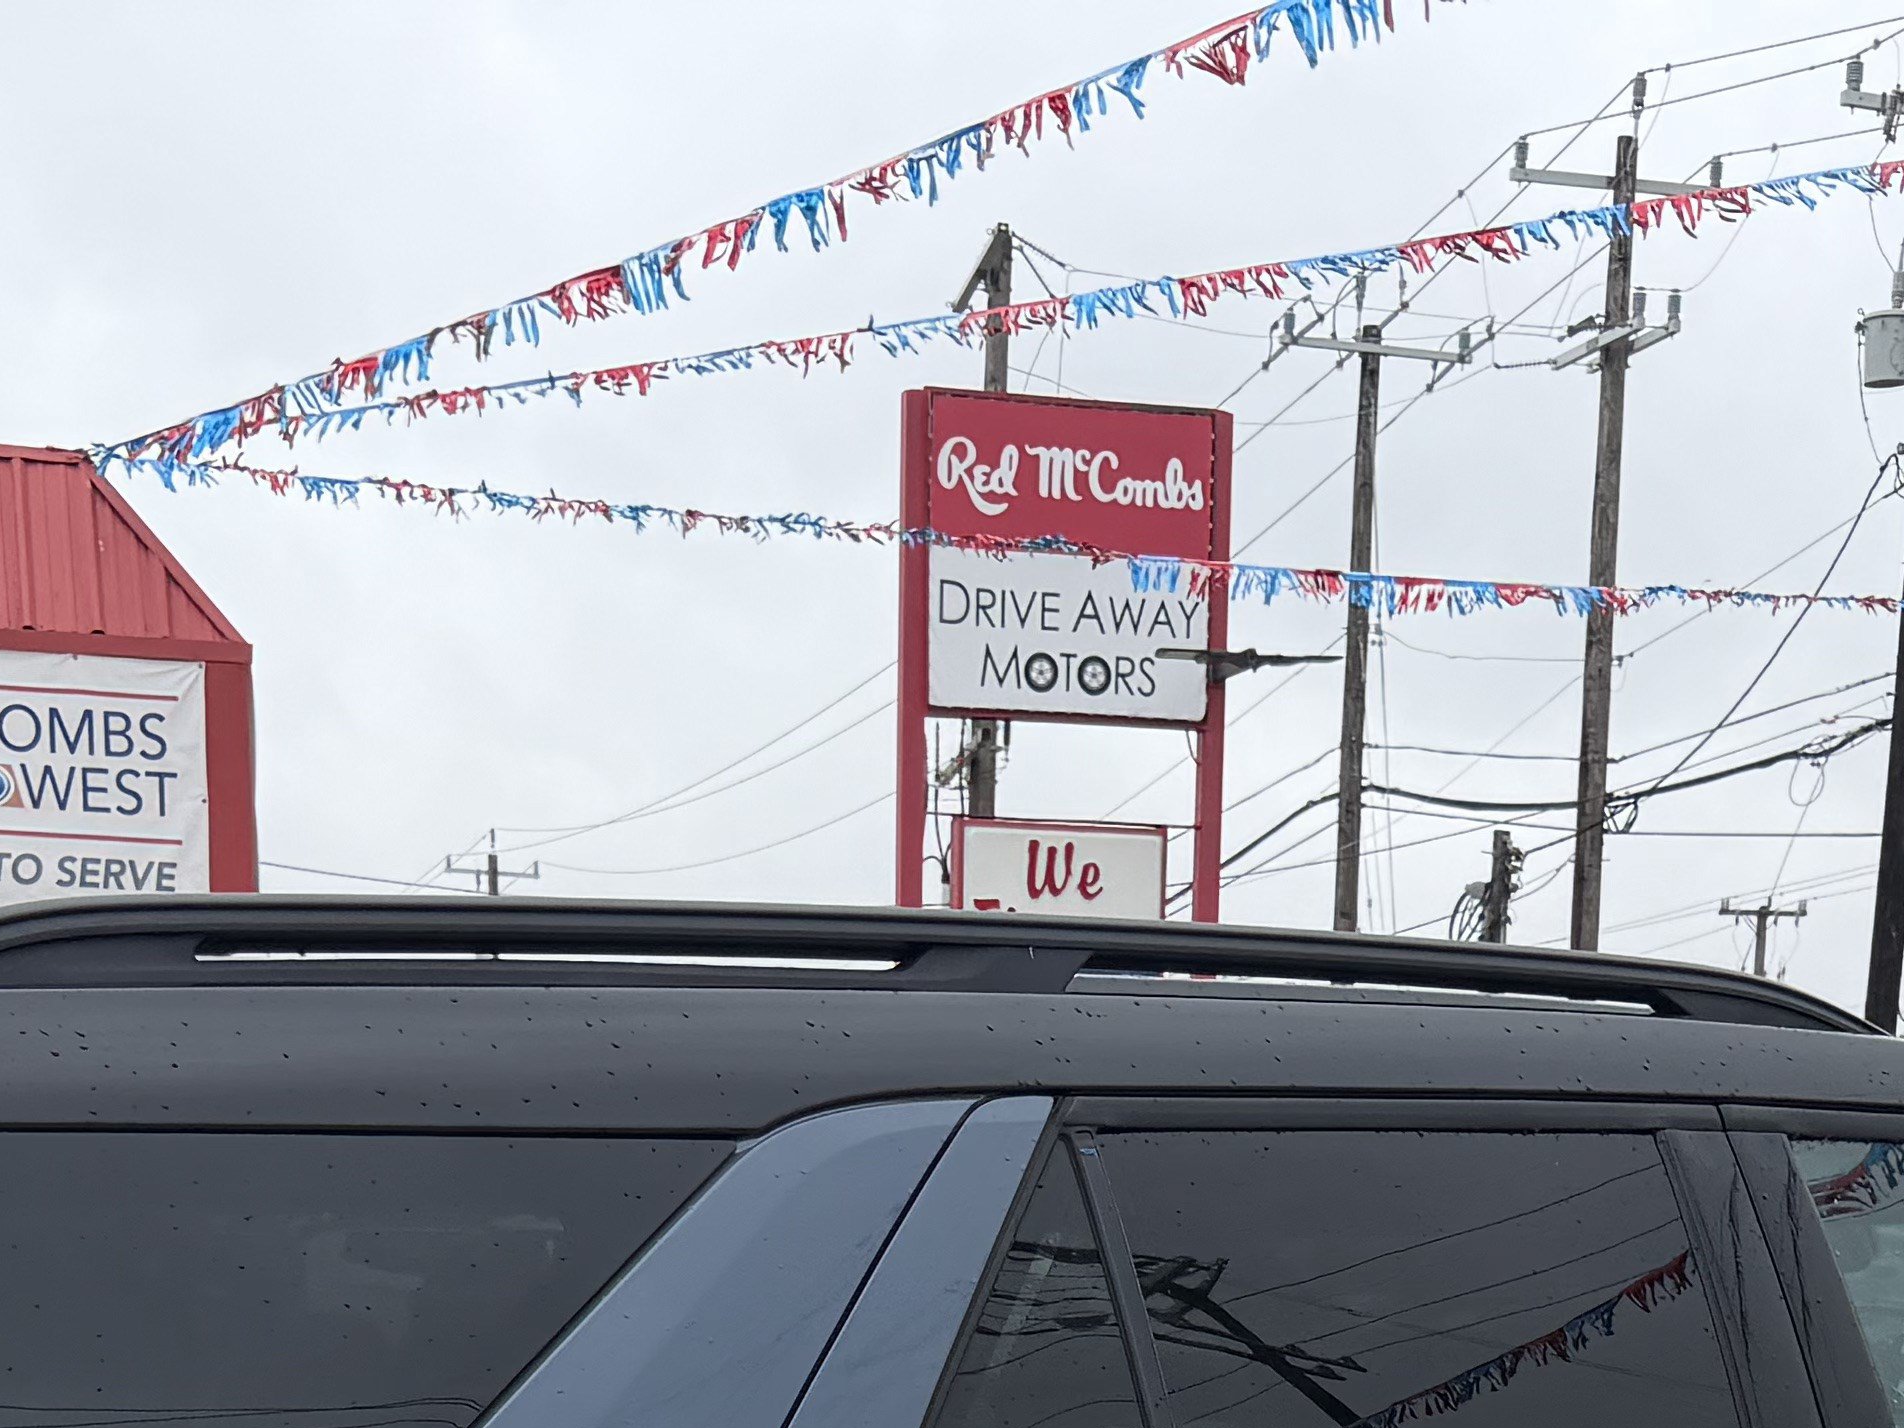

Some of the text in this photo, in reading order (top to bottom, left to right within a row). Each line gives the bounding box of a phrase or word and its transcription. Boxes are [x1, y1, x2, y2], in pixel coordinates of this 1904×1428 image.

[936, 435, 1204, 517] Red McCombs
[938, 577, 1200, 641] DRIVE AWAY
[18, 761, 179, 818] WEST
[54, 854, 179, 893] SERVE
[1027, 839, 1104, 901] We
